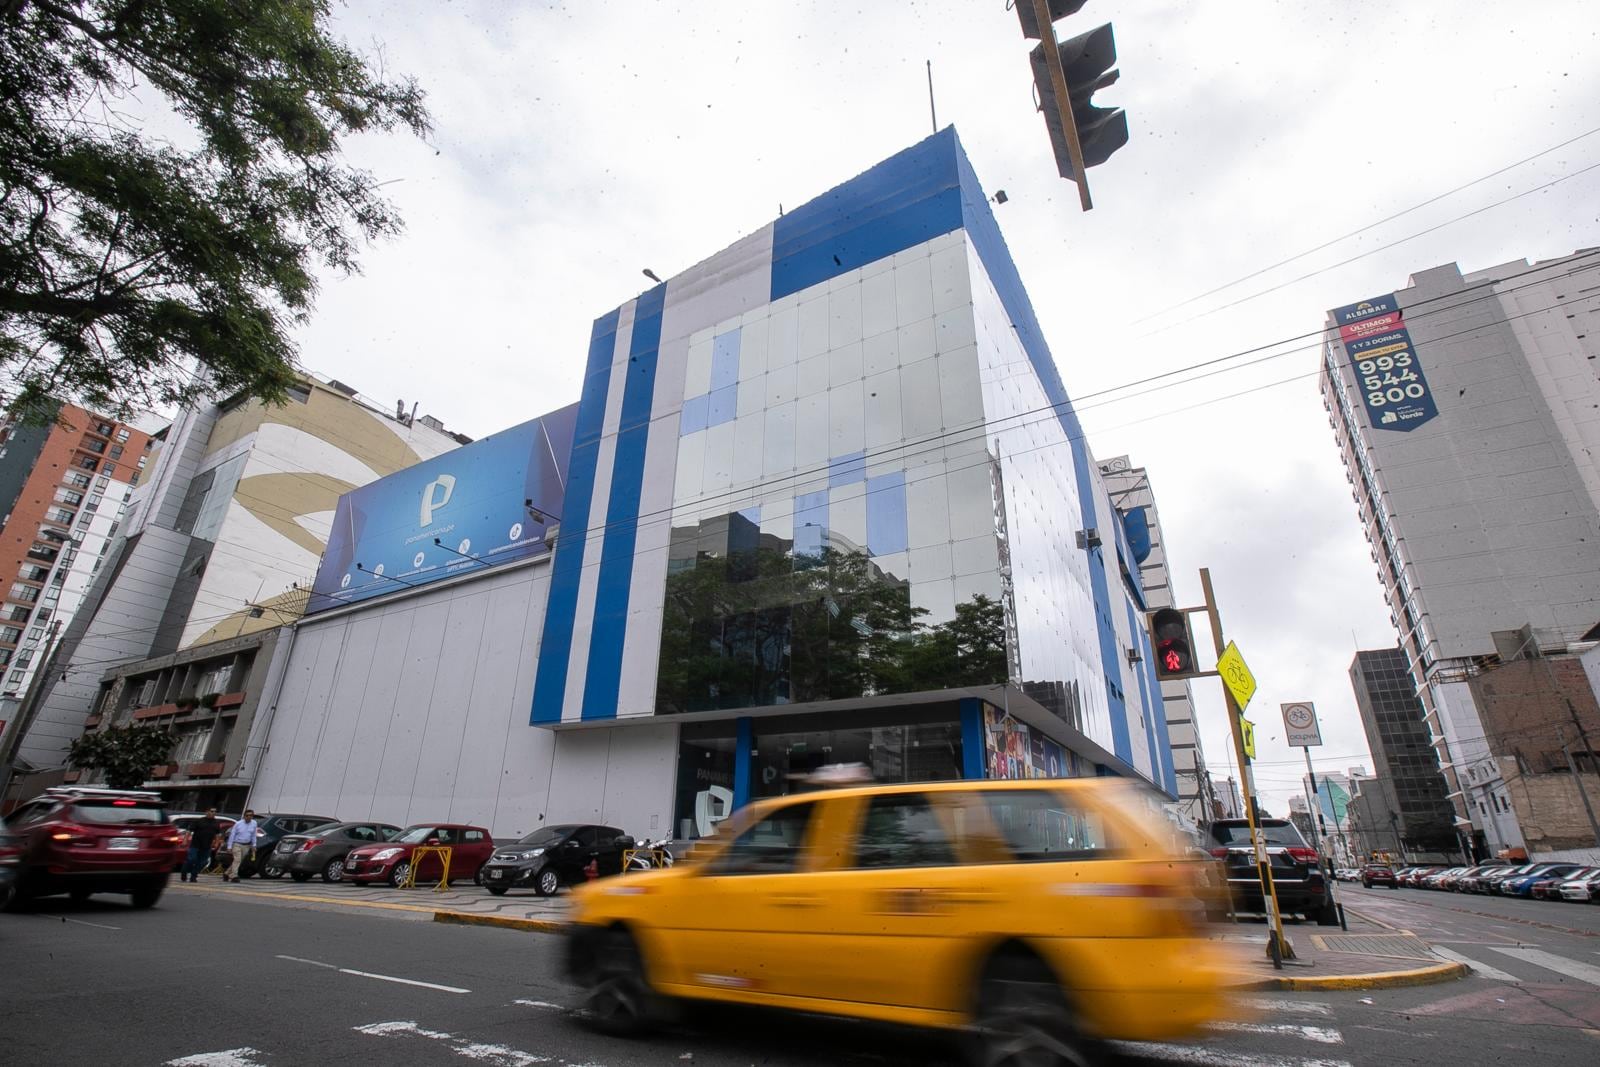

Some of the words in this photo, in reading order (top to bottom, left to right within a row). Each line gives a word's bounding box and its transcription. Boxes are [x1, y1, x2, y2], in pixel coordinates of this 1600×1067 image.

[1346, 304, 1387, 320] ALBAMAR
[1350, 317, 1393, 332] ÚLTIMOS
[1359, 352, 1412, 375] 993
[1364, 368, 1418, 391] 544
[1368, 383, 1424, 407] 800
[1399, 411, 1424, 420] Verde
